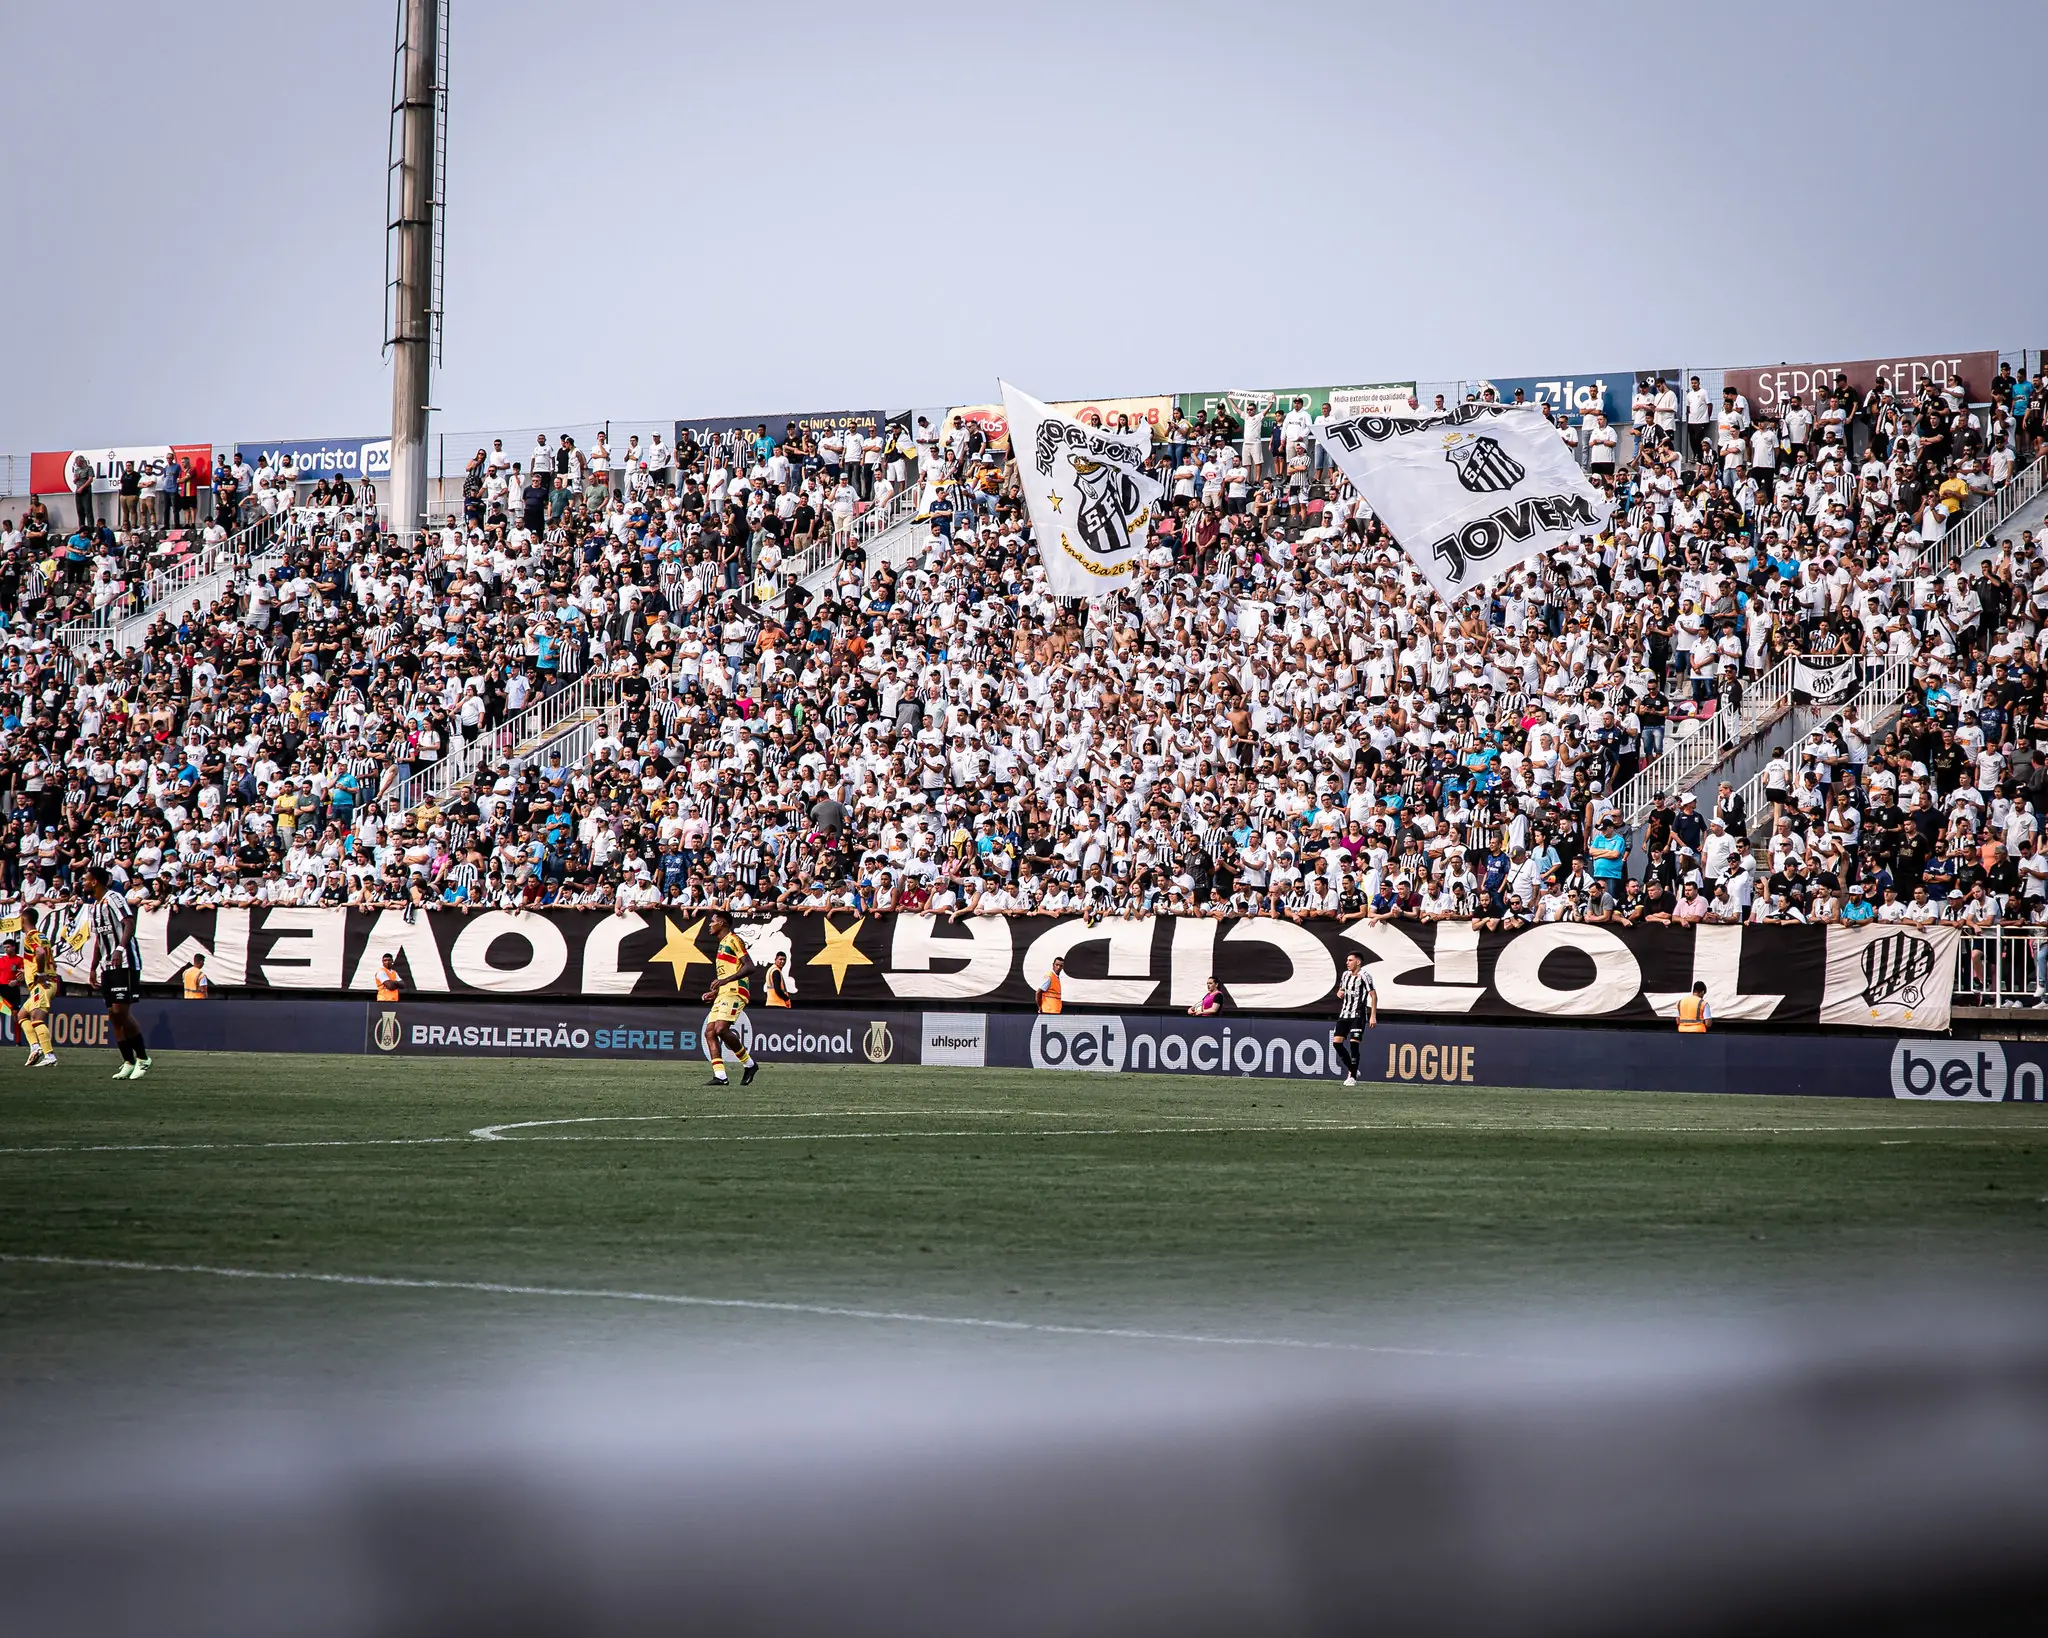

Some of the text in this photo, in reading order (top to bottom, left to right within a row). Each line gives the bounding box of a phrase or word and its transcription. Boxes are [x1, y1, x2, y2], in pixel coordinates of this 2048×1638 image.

[367, 449, 390, 465] px
[1432, 493, 1602, 584] JOVEM
[1112, 563, 1125, 576] 26
[136, 905, 649, 995] JOVEM
[411, 1023, 590, 1049] BRASILEIRÃO
[595, 1024, 675, 1050] SÉRIE
[680, 1031, 697, 1051] B
[754, 1028, 853, 1054] nacional
[931, 1036, 979, 1049] uhlsport
[1385, 1043, 1475, 1082] JOGUE
